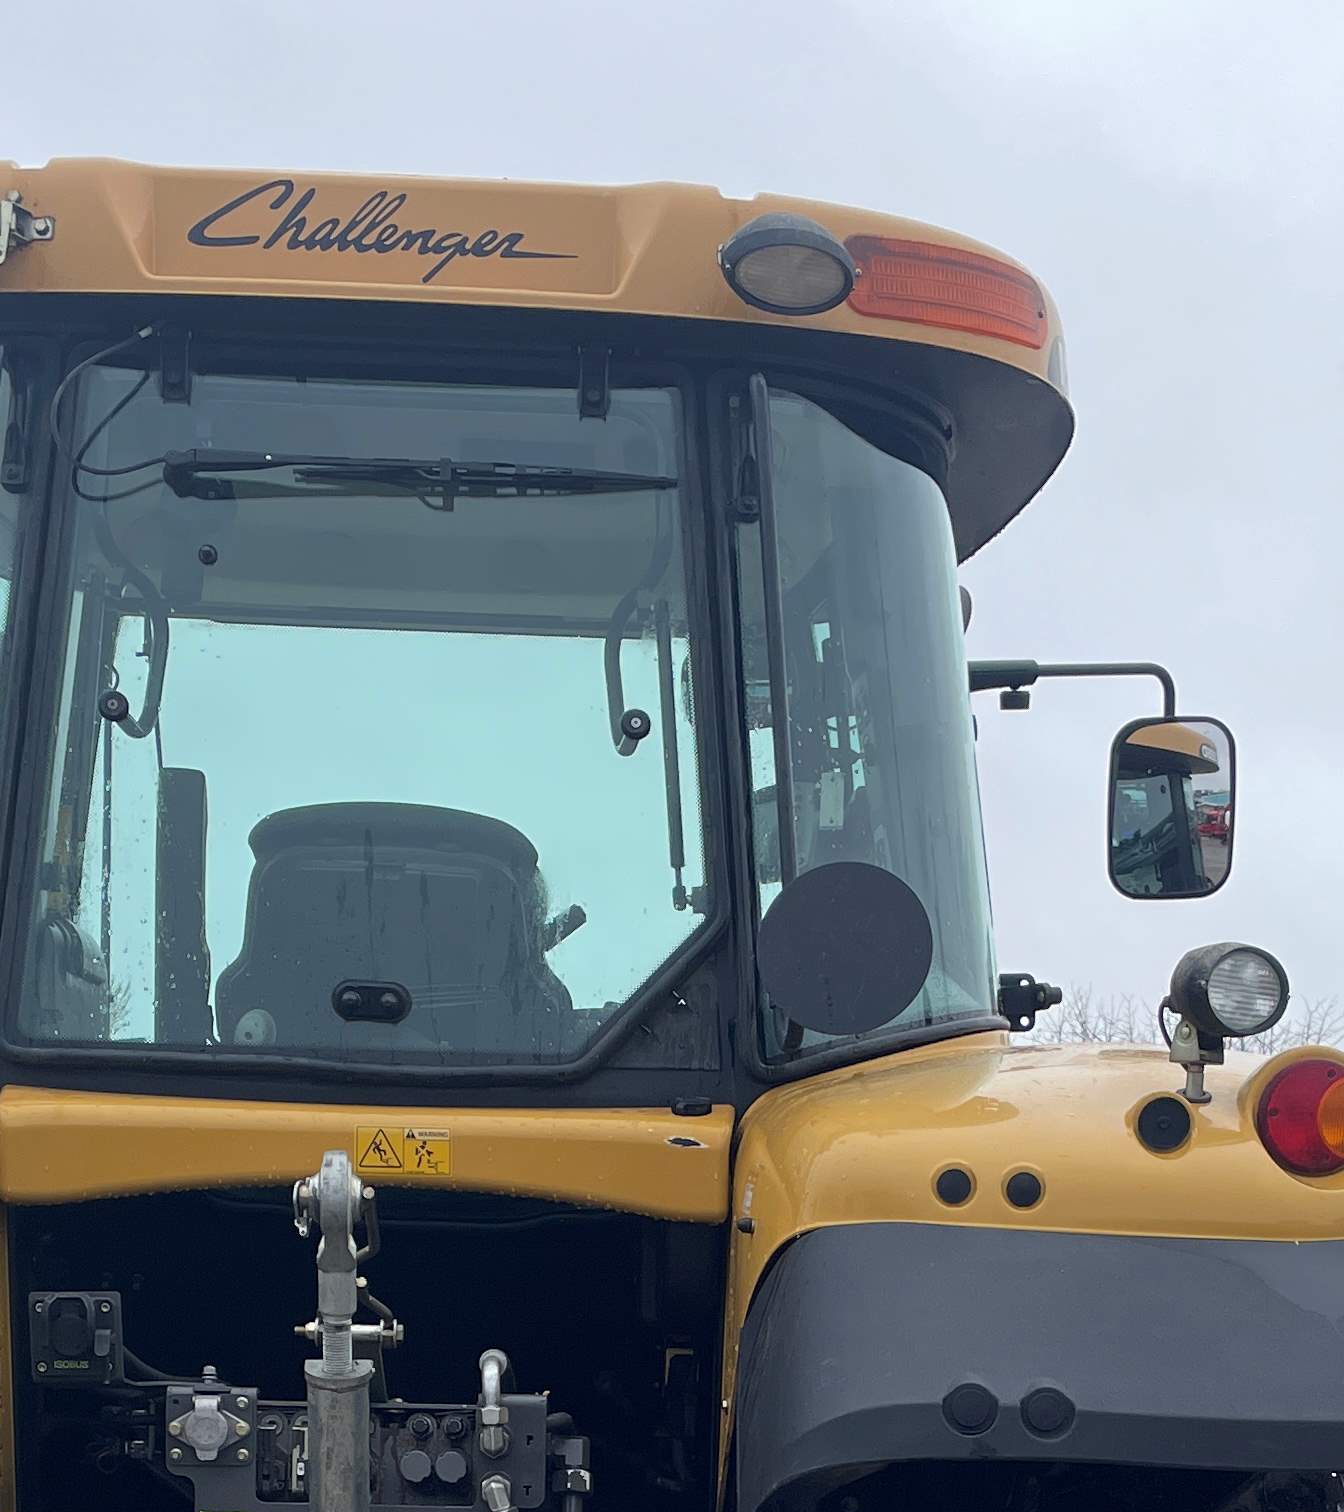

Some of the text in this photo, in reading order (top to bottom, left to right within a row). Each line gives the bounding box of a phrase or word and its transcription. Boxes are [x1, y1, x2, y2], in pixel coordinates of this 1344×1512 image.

[187, 179, 578, 283] Challenger
[53, 1359, 89, 1369] ISOBUS
[526, 1435, 534, 1446] P
[523, 1485, 532, 1496] T
